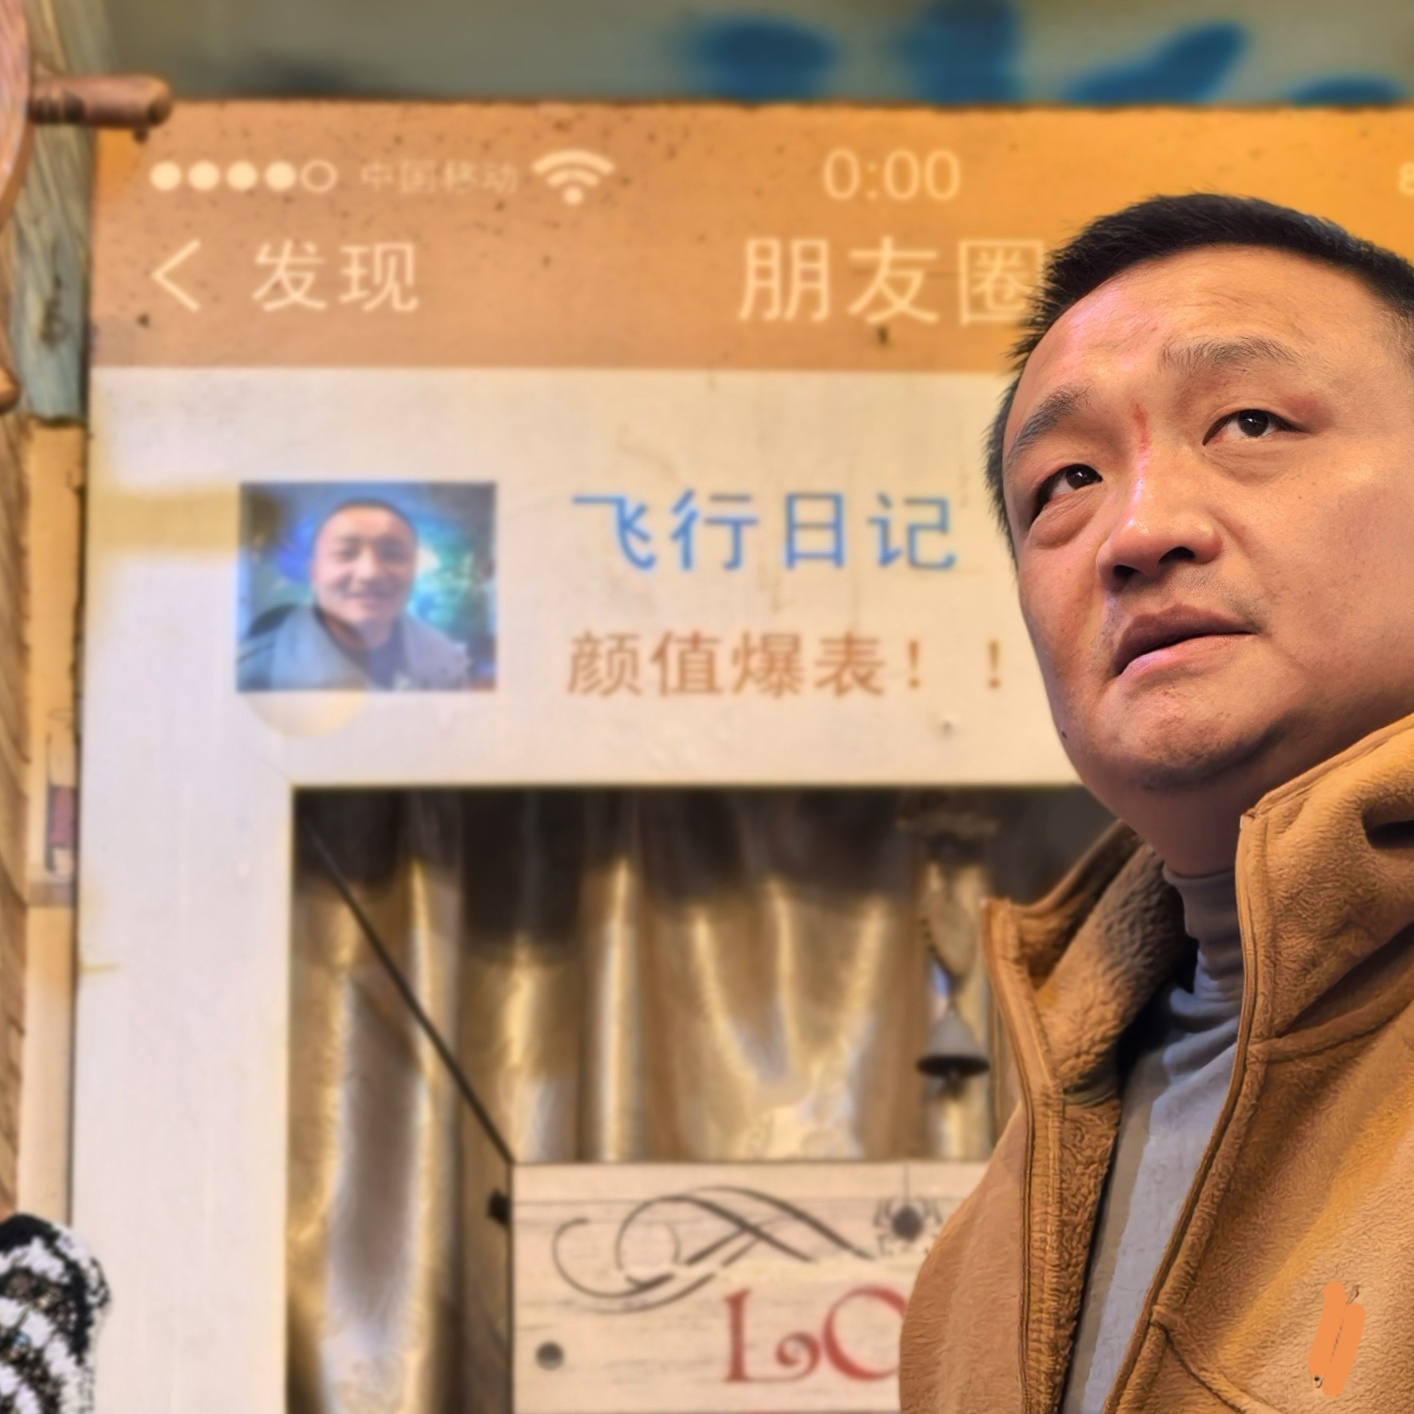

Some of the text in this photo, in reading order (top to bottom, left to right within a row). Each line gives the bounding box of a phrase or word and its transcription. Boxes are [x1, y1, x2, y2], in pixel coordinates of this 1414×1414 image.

[822, 149, 963, 203] 0:00
[252, 239, 420, 313] 发现
[738, 236, 1046, 328] 朋友圈
[570, 488, 957, 573] 飞行日记
